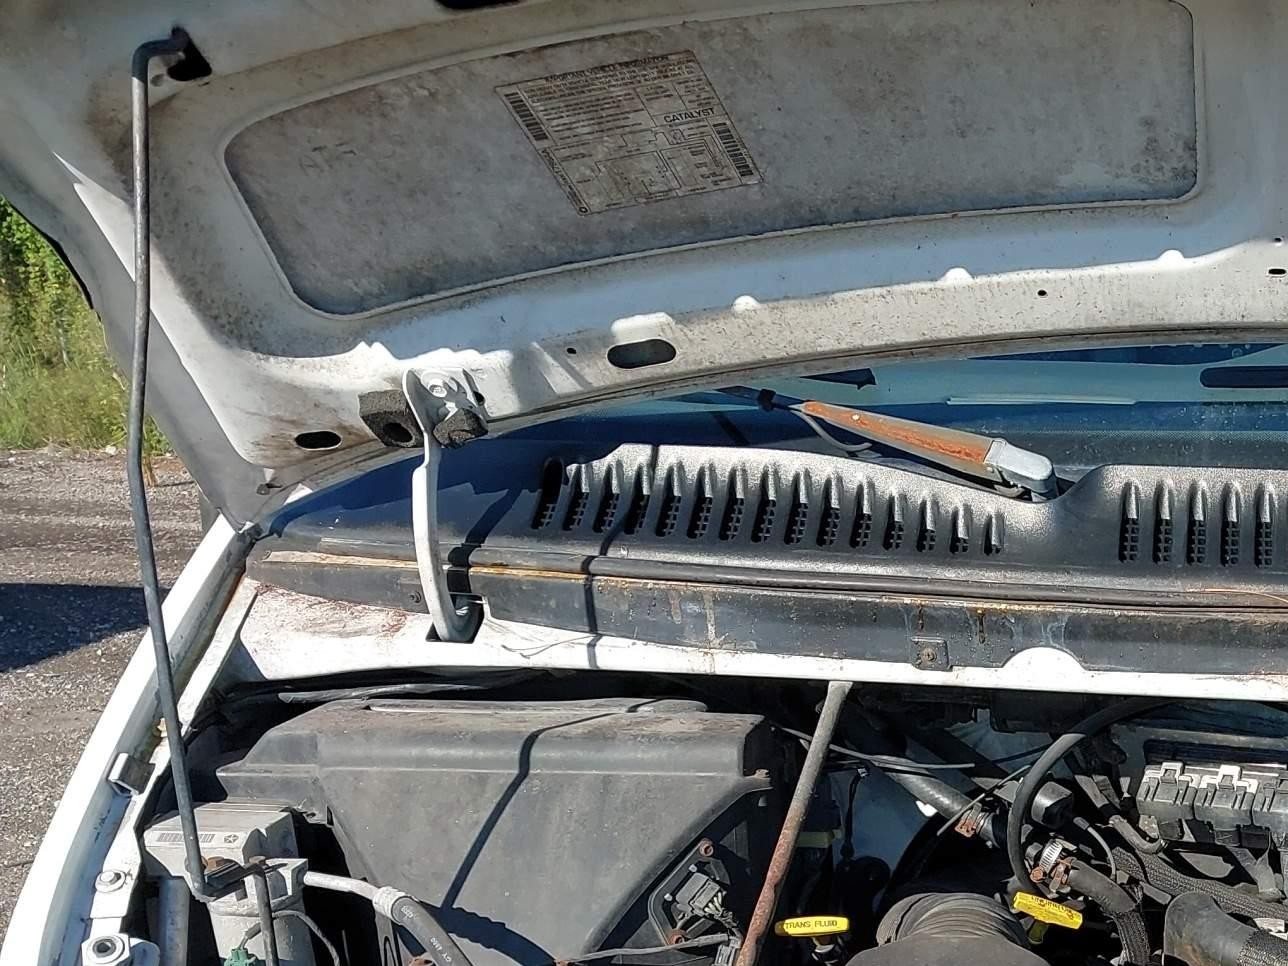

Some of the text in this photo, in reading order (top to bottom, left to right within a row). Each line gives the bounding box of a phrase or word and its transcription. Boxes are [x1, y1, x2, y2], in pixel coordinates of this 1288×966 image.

[663, 107, 715, 123] CATALYST
[784, 919, 838, 930] TRANS FLUID
